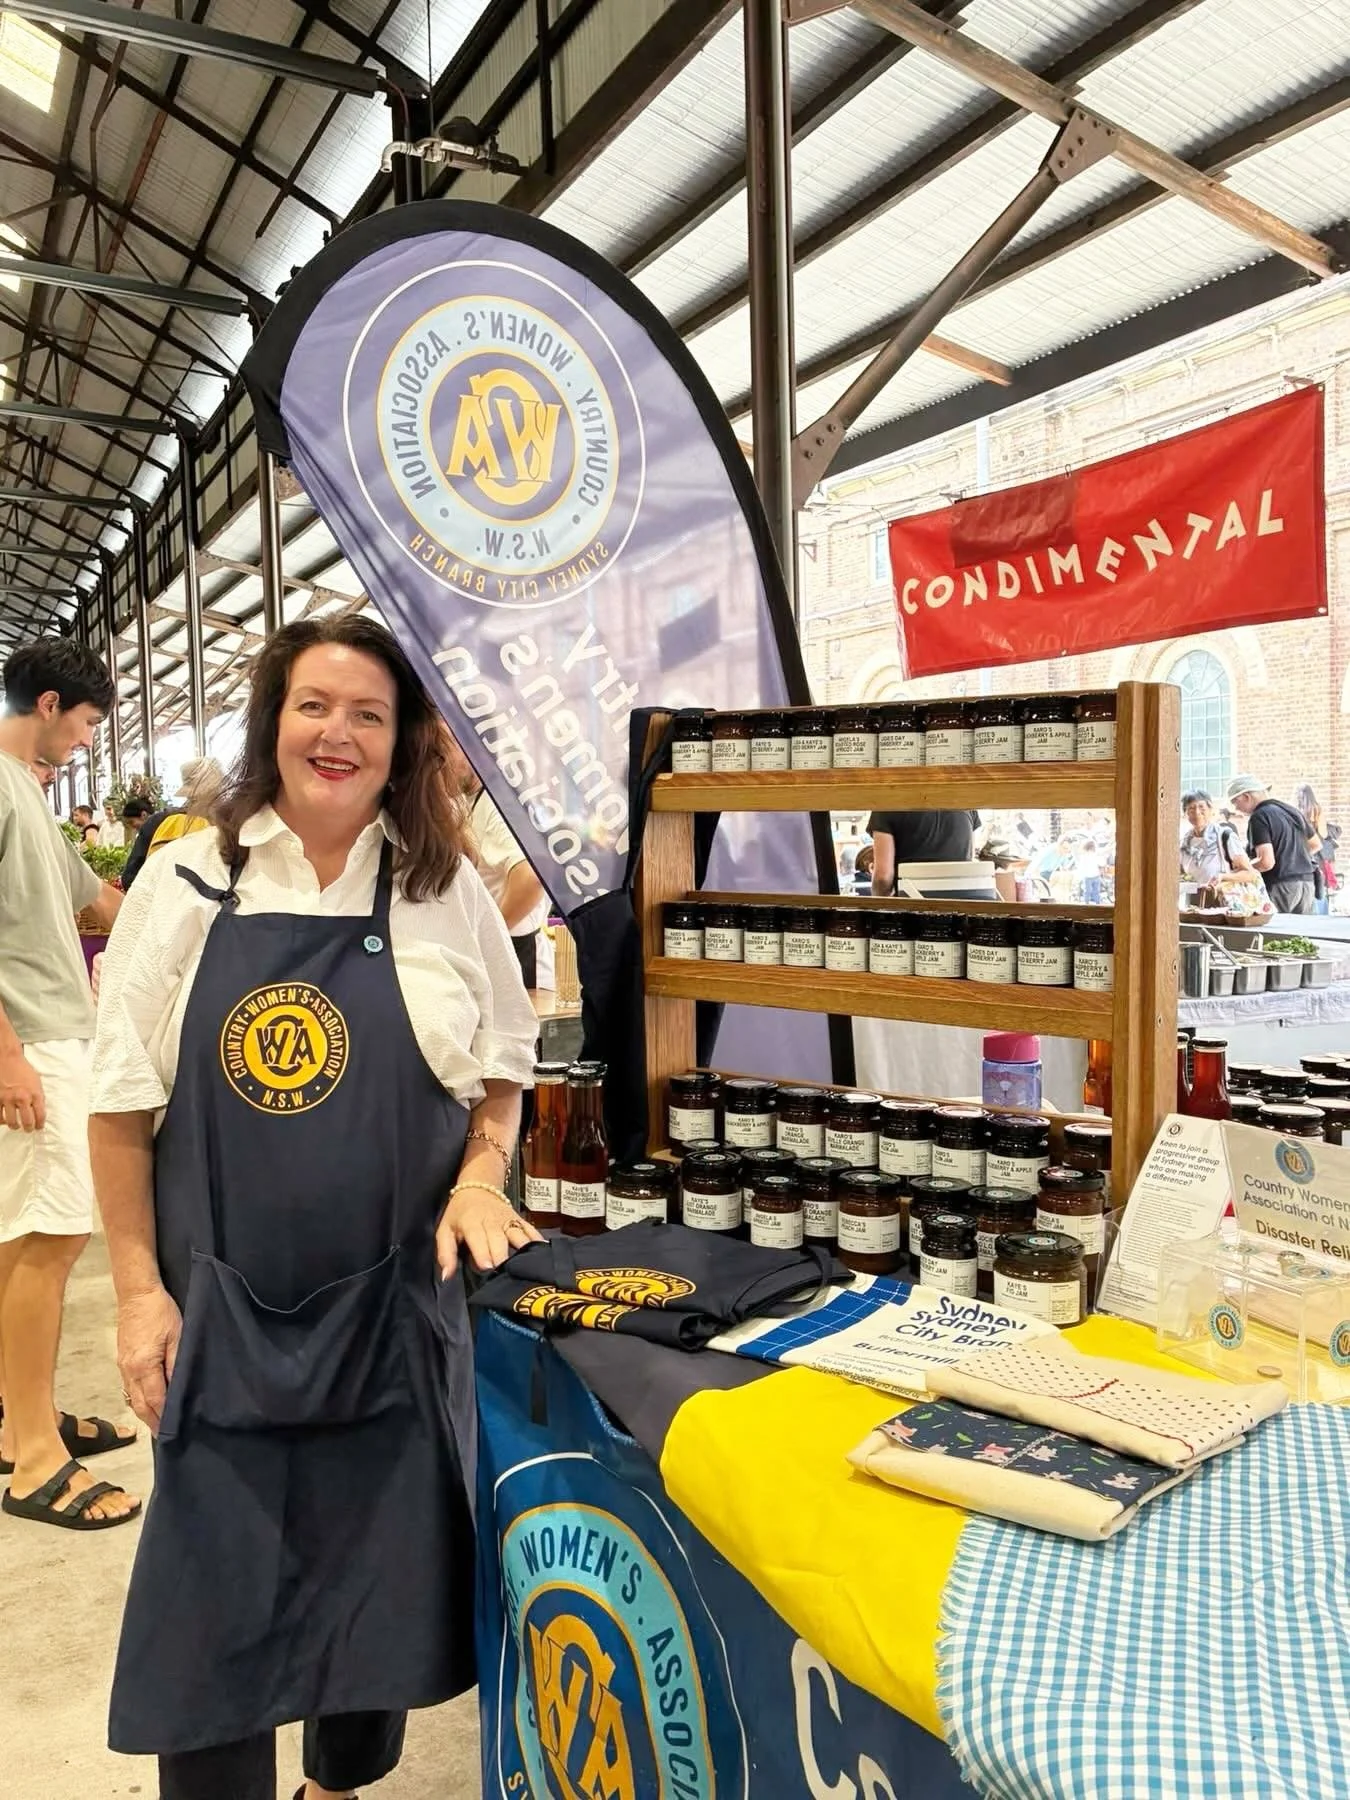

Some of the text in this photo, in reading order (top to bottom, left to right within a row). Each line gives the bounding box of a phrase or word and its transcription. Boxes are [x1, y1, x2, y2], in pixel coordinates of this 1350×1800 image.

[901, 488, 1286, 615] CONDIMENTAL
[226, 987, 345, 1080] COUNTRY WOMEN'S ASSOCIATION
[261, 1089, 311, 1109] N.S.W.
[1155, 1147, 1221, 1167] progressive group
[1159, 1139, 1178, 1149] Keen
[1178, 1143, 1187, 1151] to
[1186, 1144, 1202, 1153] join
[1148, 1163, 1163, 1172] who
[1177, 1170, 1207, 1182] making
[1152, 1155, 1216, 1174] of Sydney women
[1151, 1172, 1193, 1187] difference?
[1243, 1173, 1295, 1200] Country
[1243, 1191, 1318, 1222] Association
[1320, 1213, 1335, 1227] of
[1255, 1218, 1316, 1250] Disaster
[895, 1323, 950, 1342] City
[911, 1310, 1008, 1337] Sydney
[519, 1524, 643, 1606] WOMEN'S
